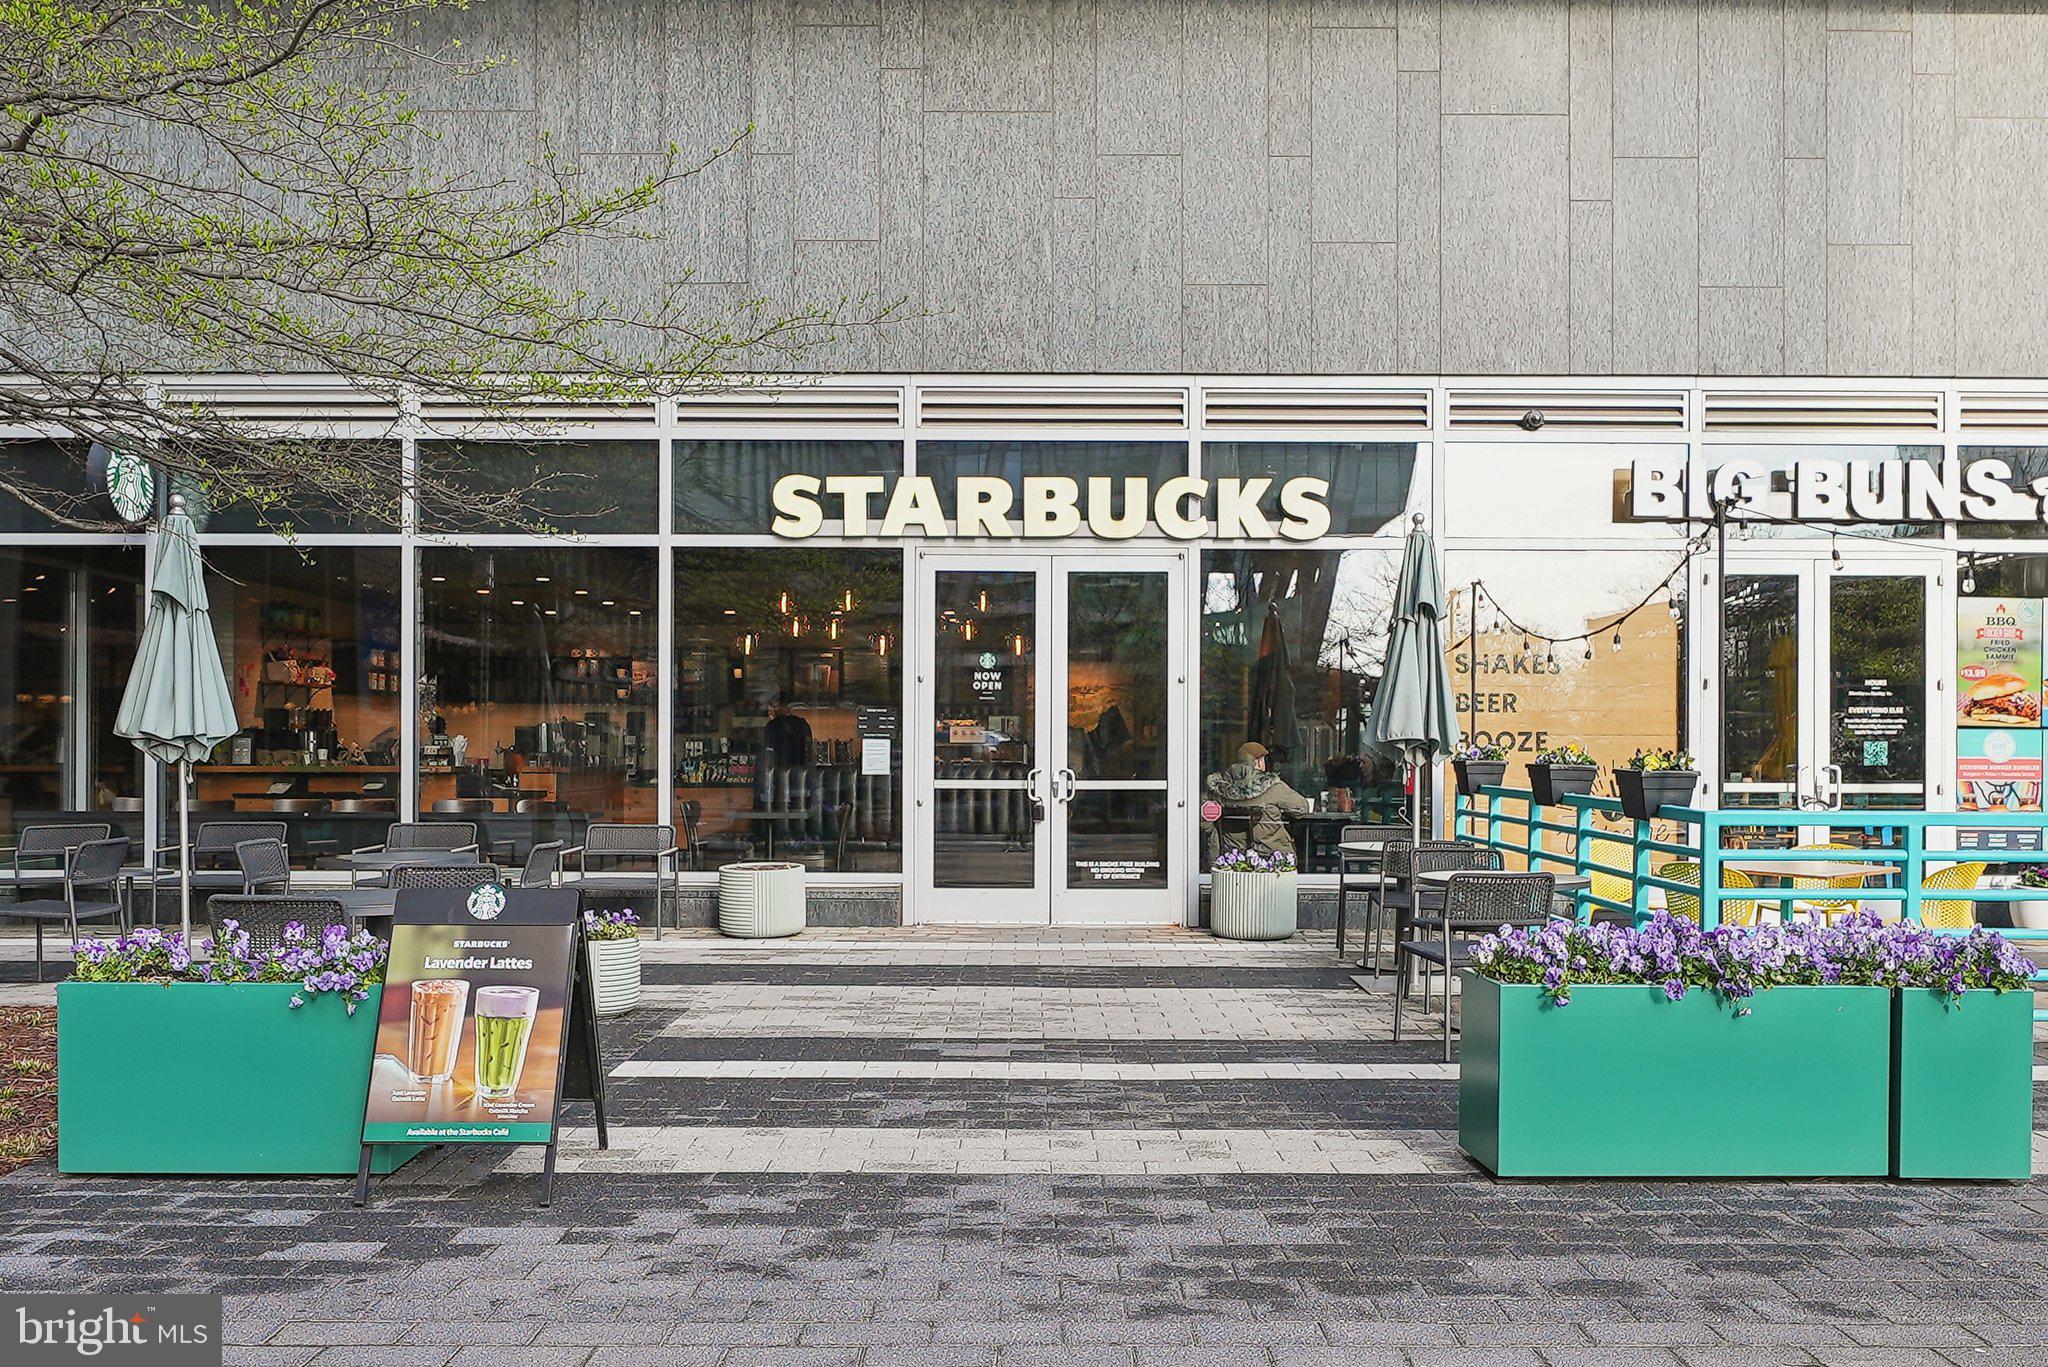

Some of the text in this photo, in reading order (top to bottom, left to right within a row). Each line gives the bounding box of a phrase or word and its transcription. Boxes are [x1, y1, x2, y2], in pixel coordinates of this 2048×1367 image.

[1631, 459, 1768, 520] BIG
[1795, 459, 2014, 522] BUNS
[771, 474, 1331, 540] STARBUCKS
[1986, 616, 2017, 626] BBQ
[973, 671, 1002, 681] NOW
[972, 681, 1003, 690] OPEN
[1455, 692, 1518, 713] BEER
[1460, 731, 1549, 752] BOOZE
[453, 940, 509, 949] STARBUCKS
[424, 955, 534, 970] Lavender Lattes
[406, 1128, 438, 1136] Available
